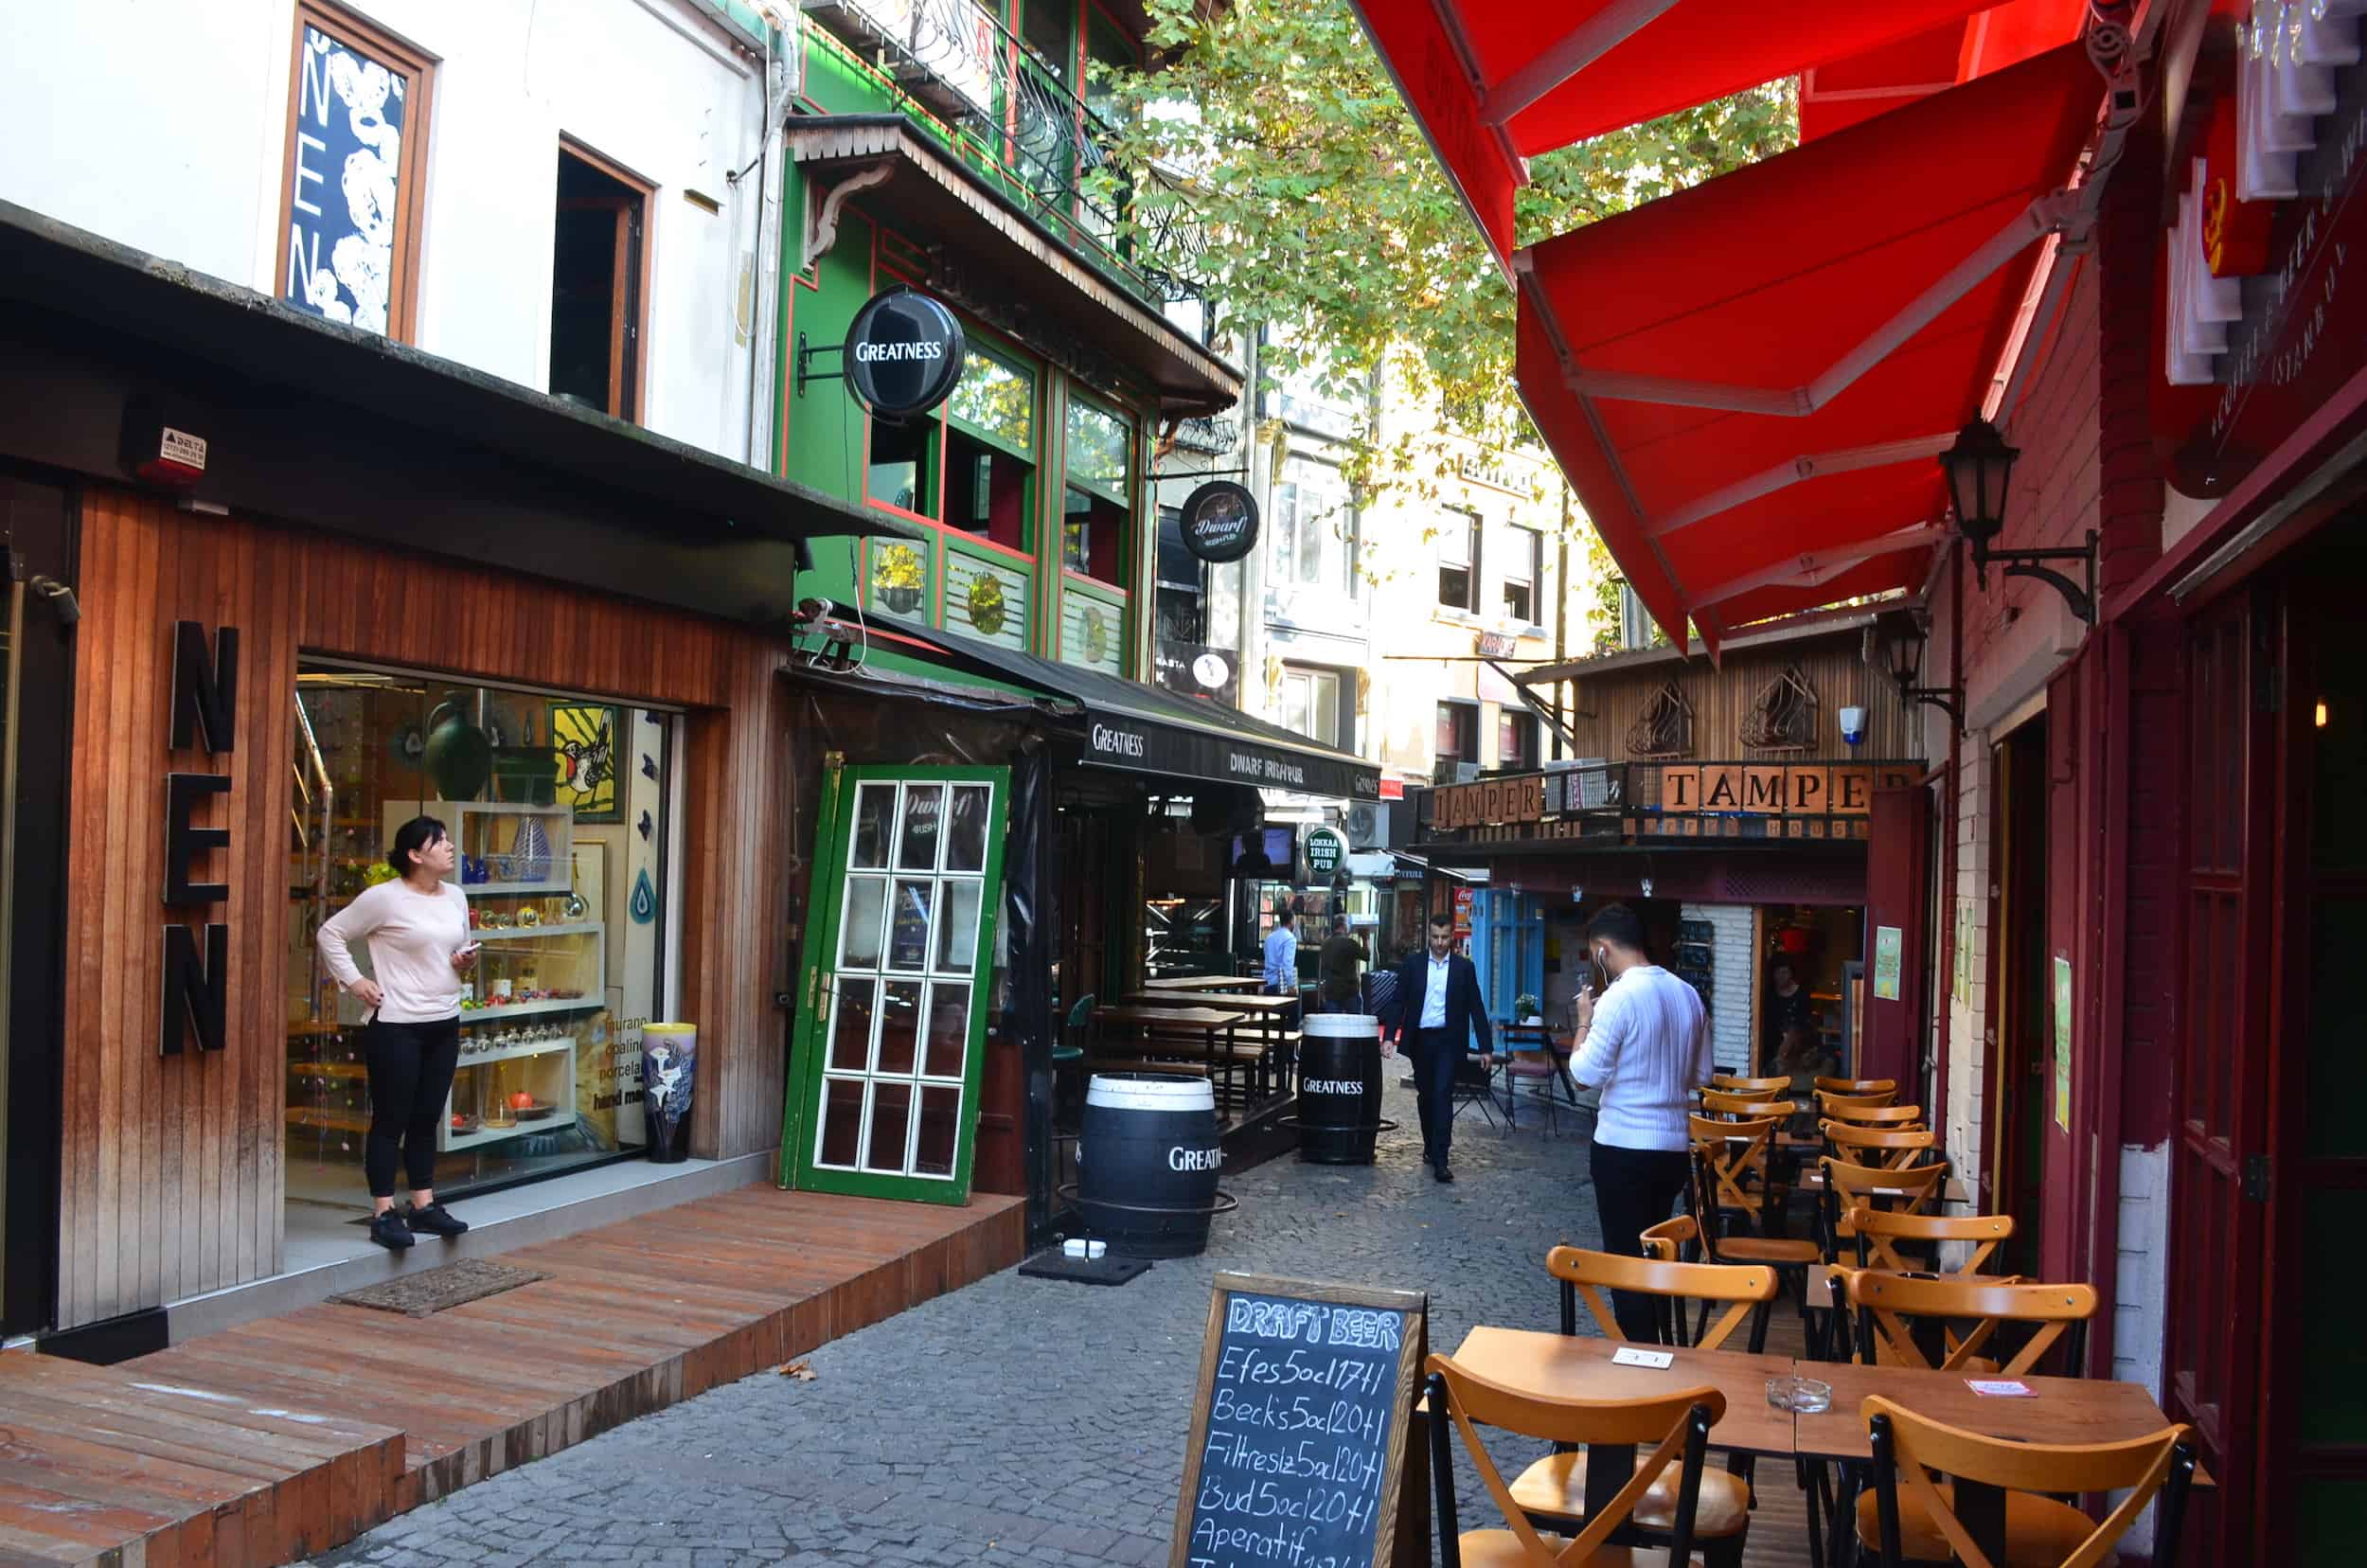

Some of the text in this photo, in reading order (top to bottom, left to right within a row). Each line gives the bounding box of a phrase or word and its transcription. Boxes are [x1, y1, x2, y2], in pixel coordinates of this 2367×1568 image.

[287, 41, 331, 309] NEN
[855, 340, 942, 364] GREATNESS
[177, 437, 205, 453] DELTA
[1195, 516, 1249, 535] Dwarf
[1093, 722, 1144, 757] GREATNESS
[1230, 753, 1304, 784] DWARF IRISH PUB
[1436, 785, 1535, 820] TAMPER
[159, 620, 240, 1057] NEN
[1309, 847, 1337, 858] IRISH
[1313, 859, 1333, 869] PUB
[606, 1016, 647, 1032] murano
[599, 1060, 642, 1083] porcela
[1303, 1077, 1363, 1096] GREATNESS
[1168, 1146, 1221, 1172] GREATN
[1228, 1298, 1400, 1351] DRAFT BEER
[1218, 1345, 1280, 1384] Efes
[1198, 1474, 1256, 1513] Bud
[1192, 1517, 1318, 1568] Aperatif
